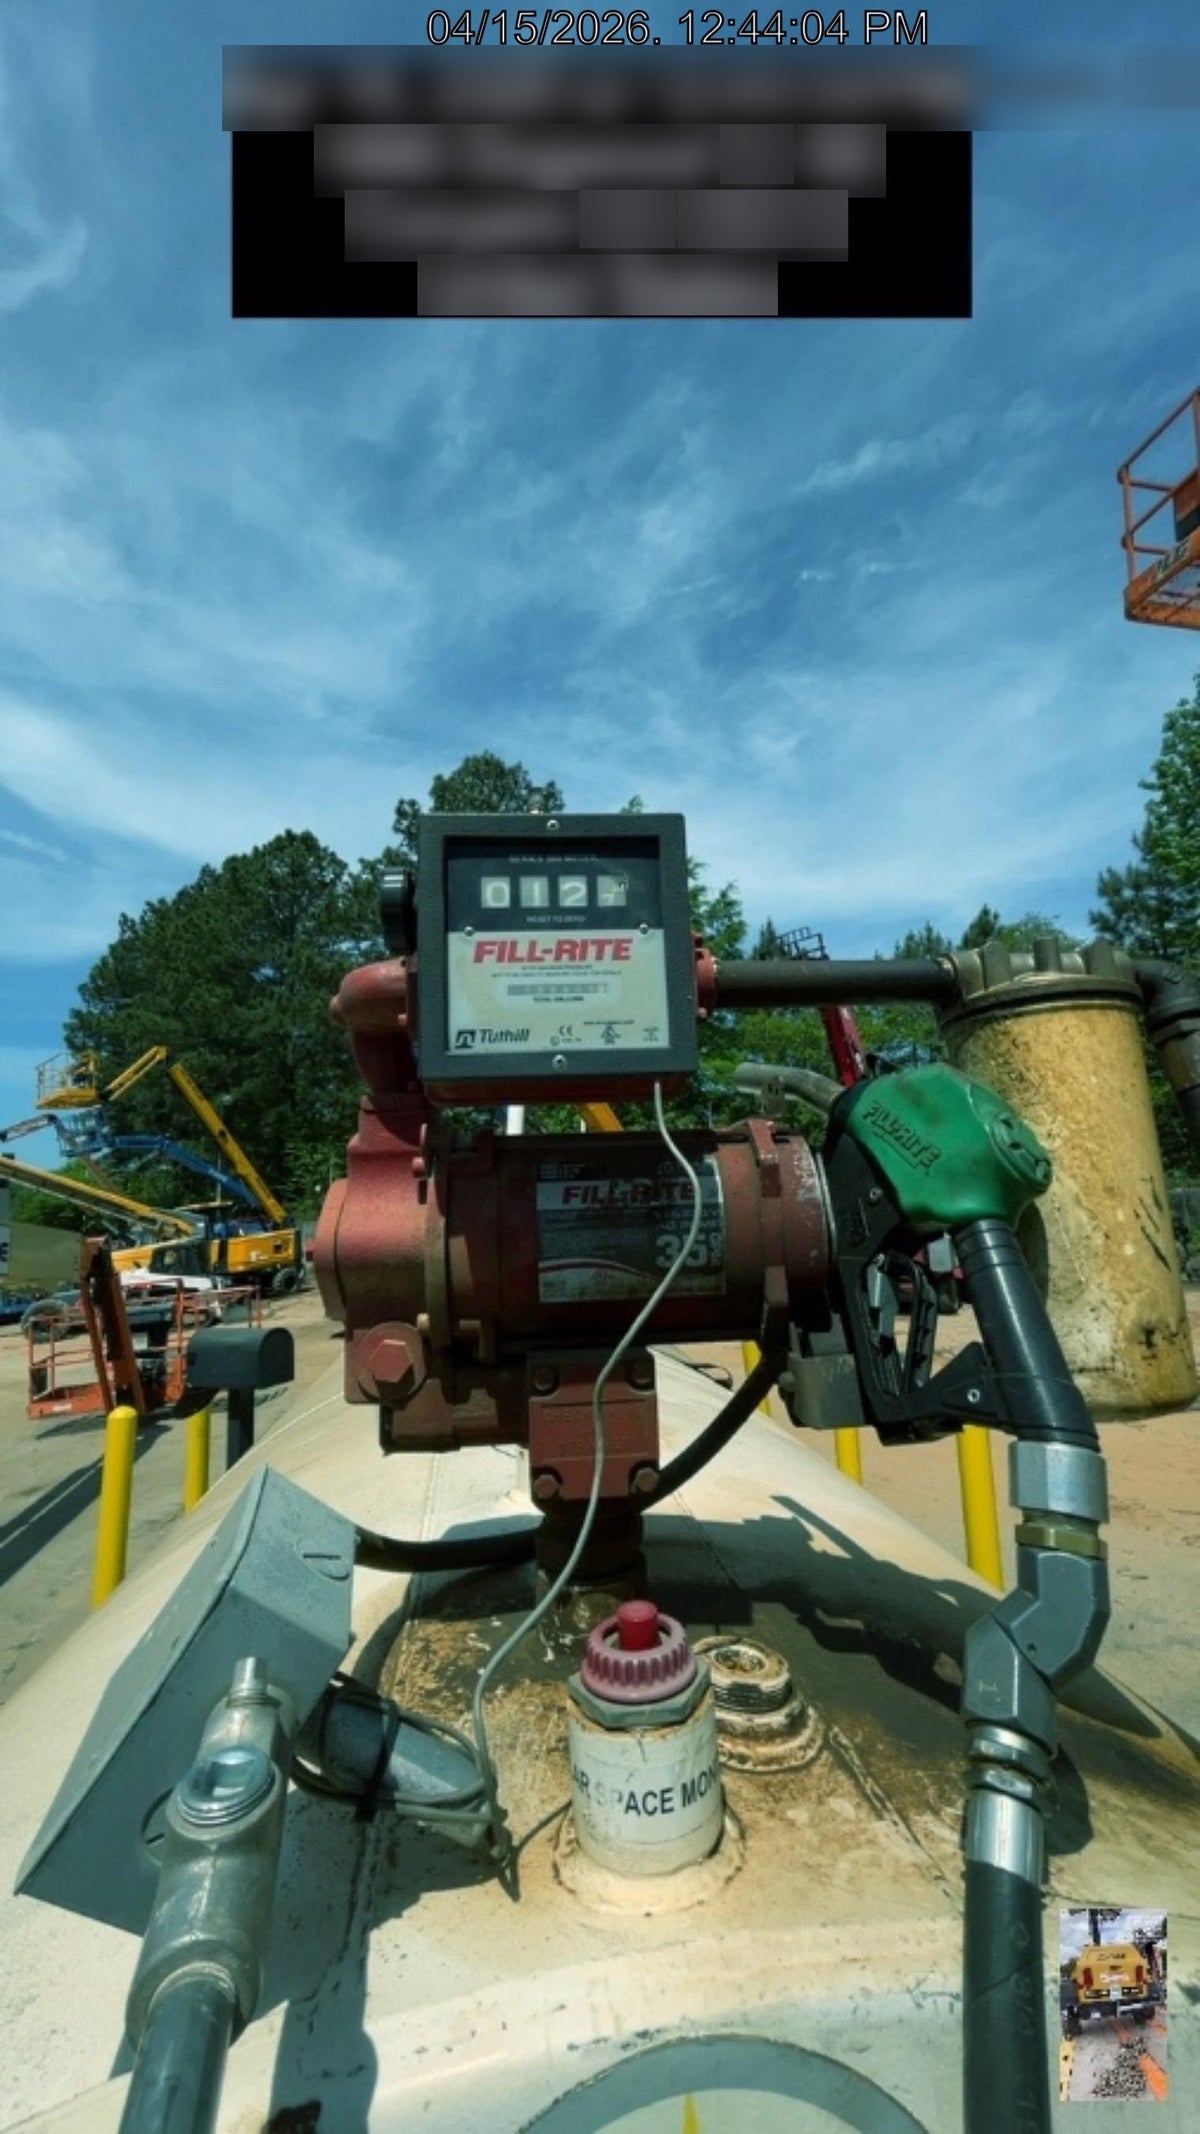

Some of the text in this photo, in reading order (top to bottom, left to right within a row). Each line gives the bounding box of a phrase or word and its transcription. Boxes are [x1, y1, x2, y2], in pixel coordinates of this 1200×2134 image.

[473, 938, 634, 964] FILL-RITE
[479, 1028, 530, 1044] Tuthill
[656, 1233, 707, 1267] 35
